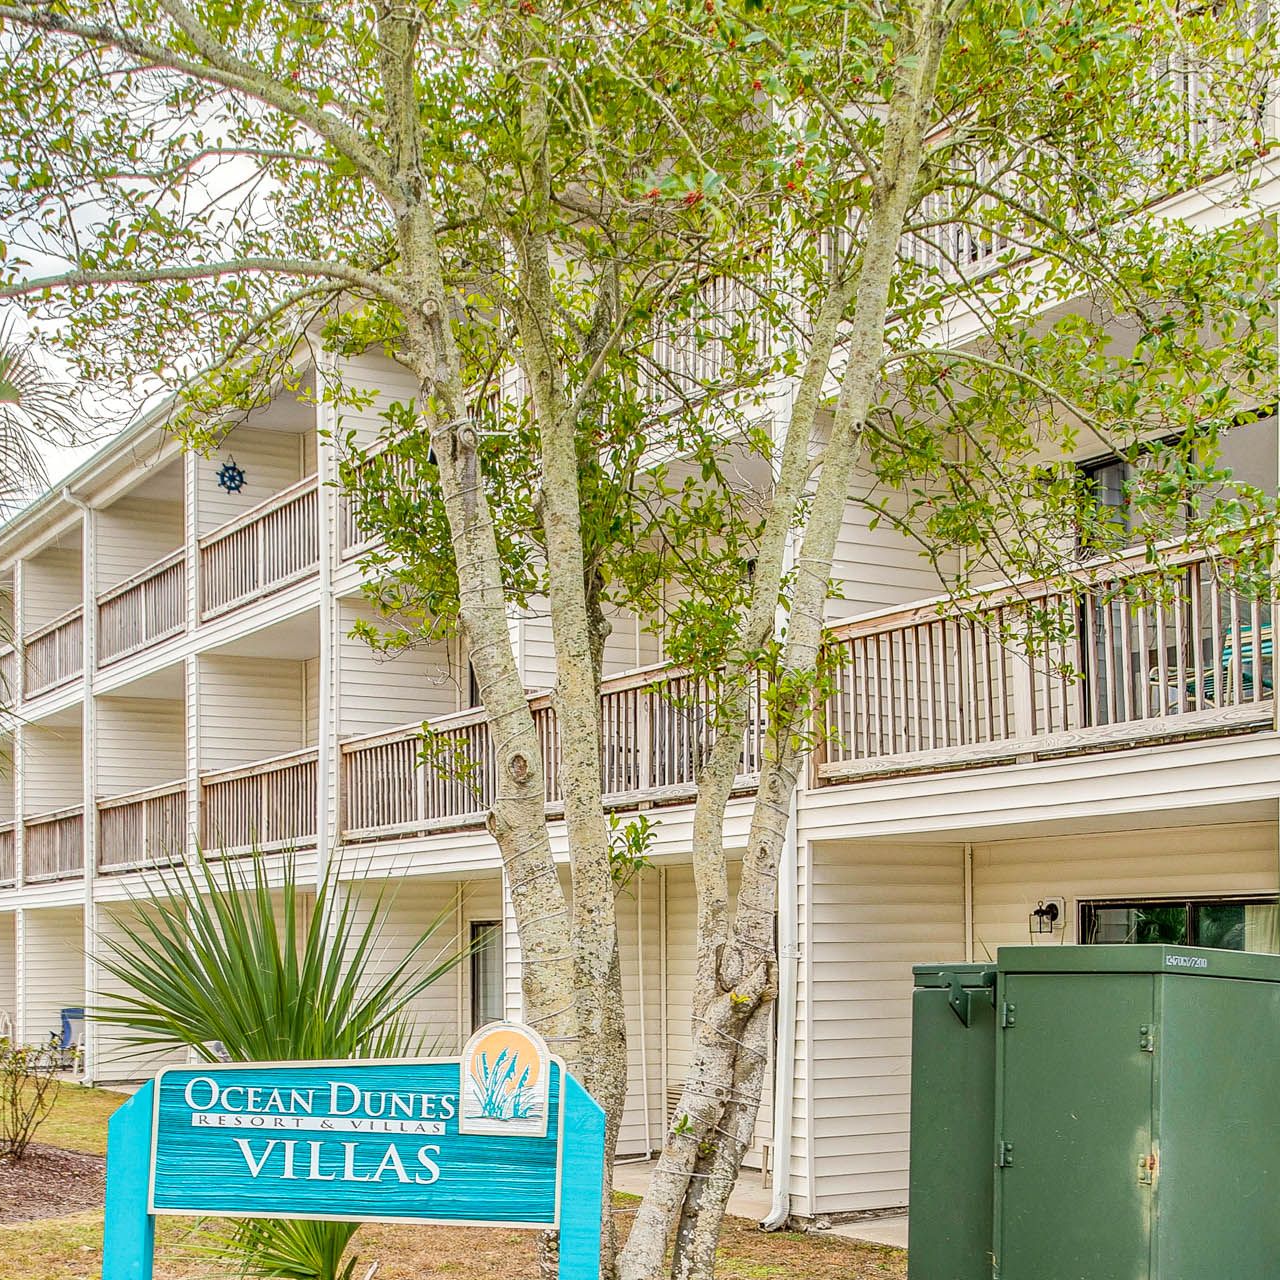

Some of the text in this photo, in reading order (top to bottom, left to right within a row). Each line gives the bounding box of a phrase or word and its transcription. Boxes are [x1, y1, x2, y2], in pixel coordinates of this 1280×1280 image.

[184, 1076, 456, 1120] OCEAN DUNES
[198, 1114, 441, 1134] RESORT & VILLAS
[232, 1138, 441, 1185] VILLAS
